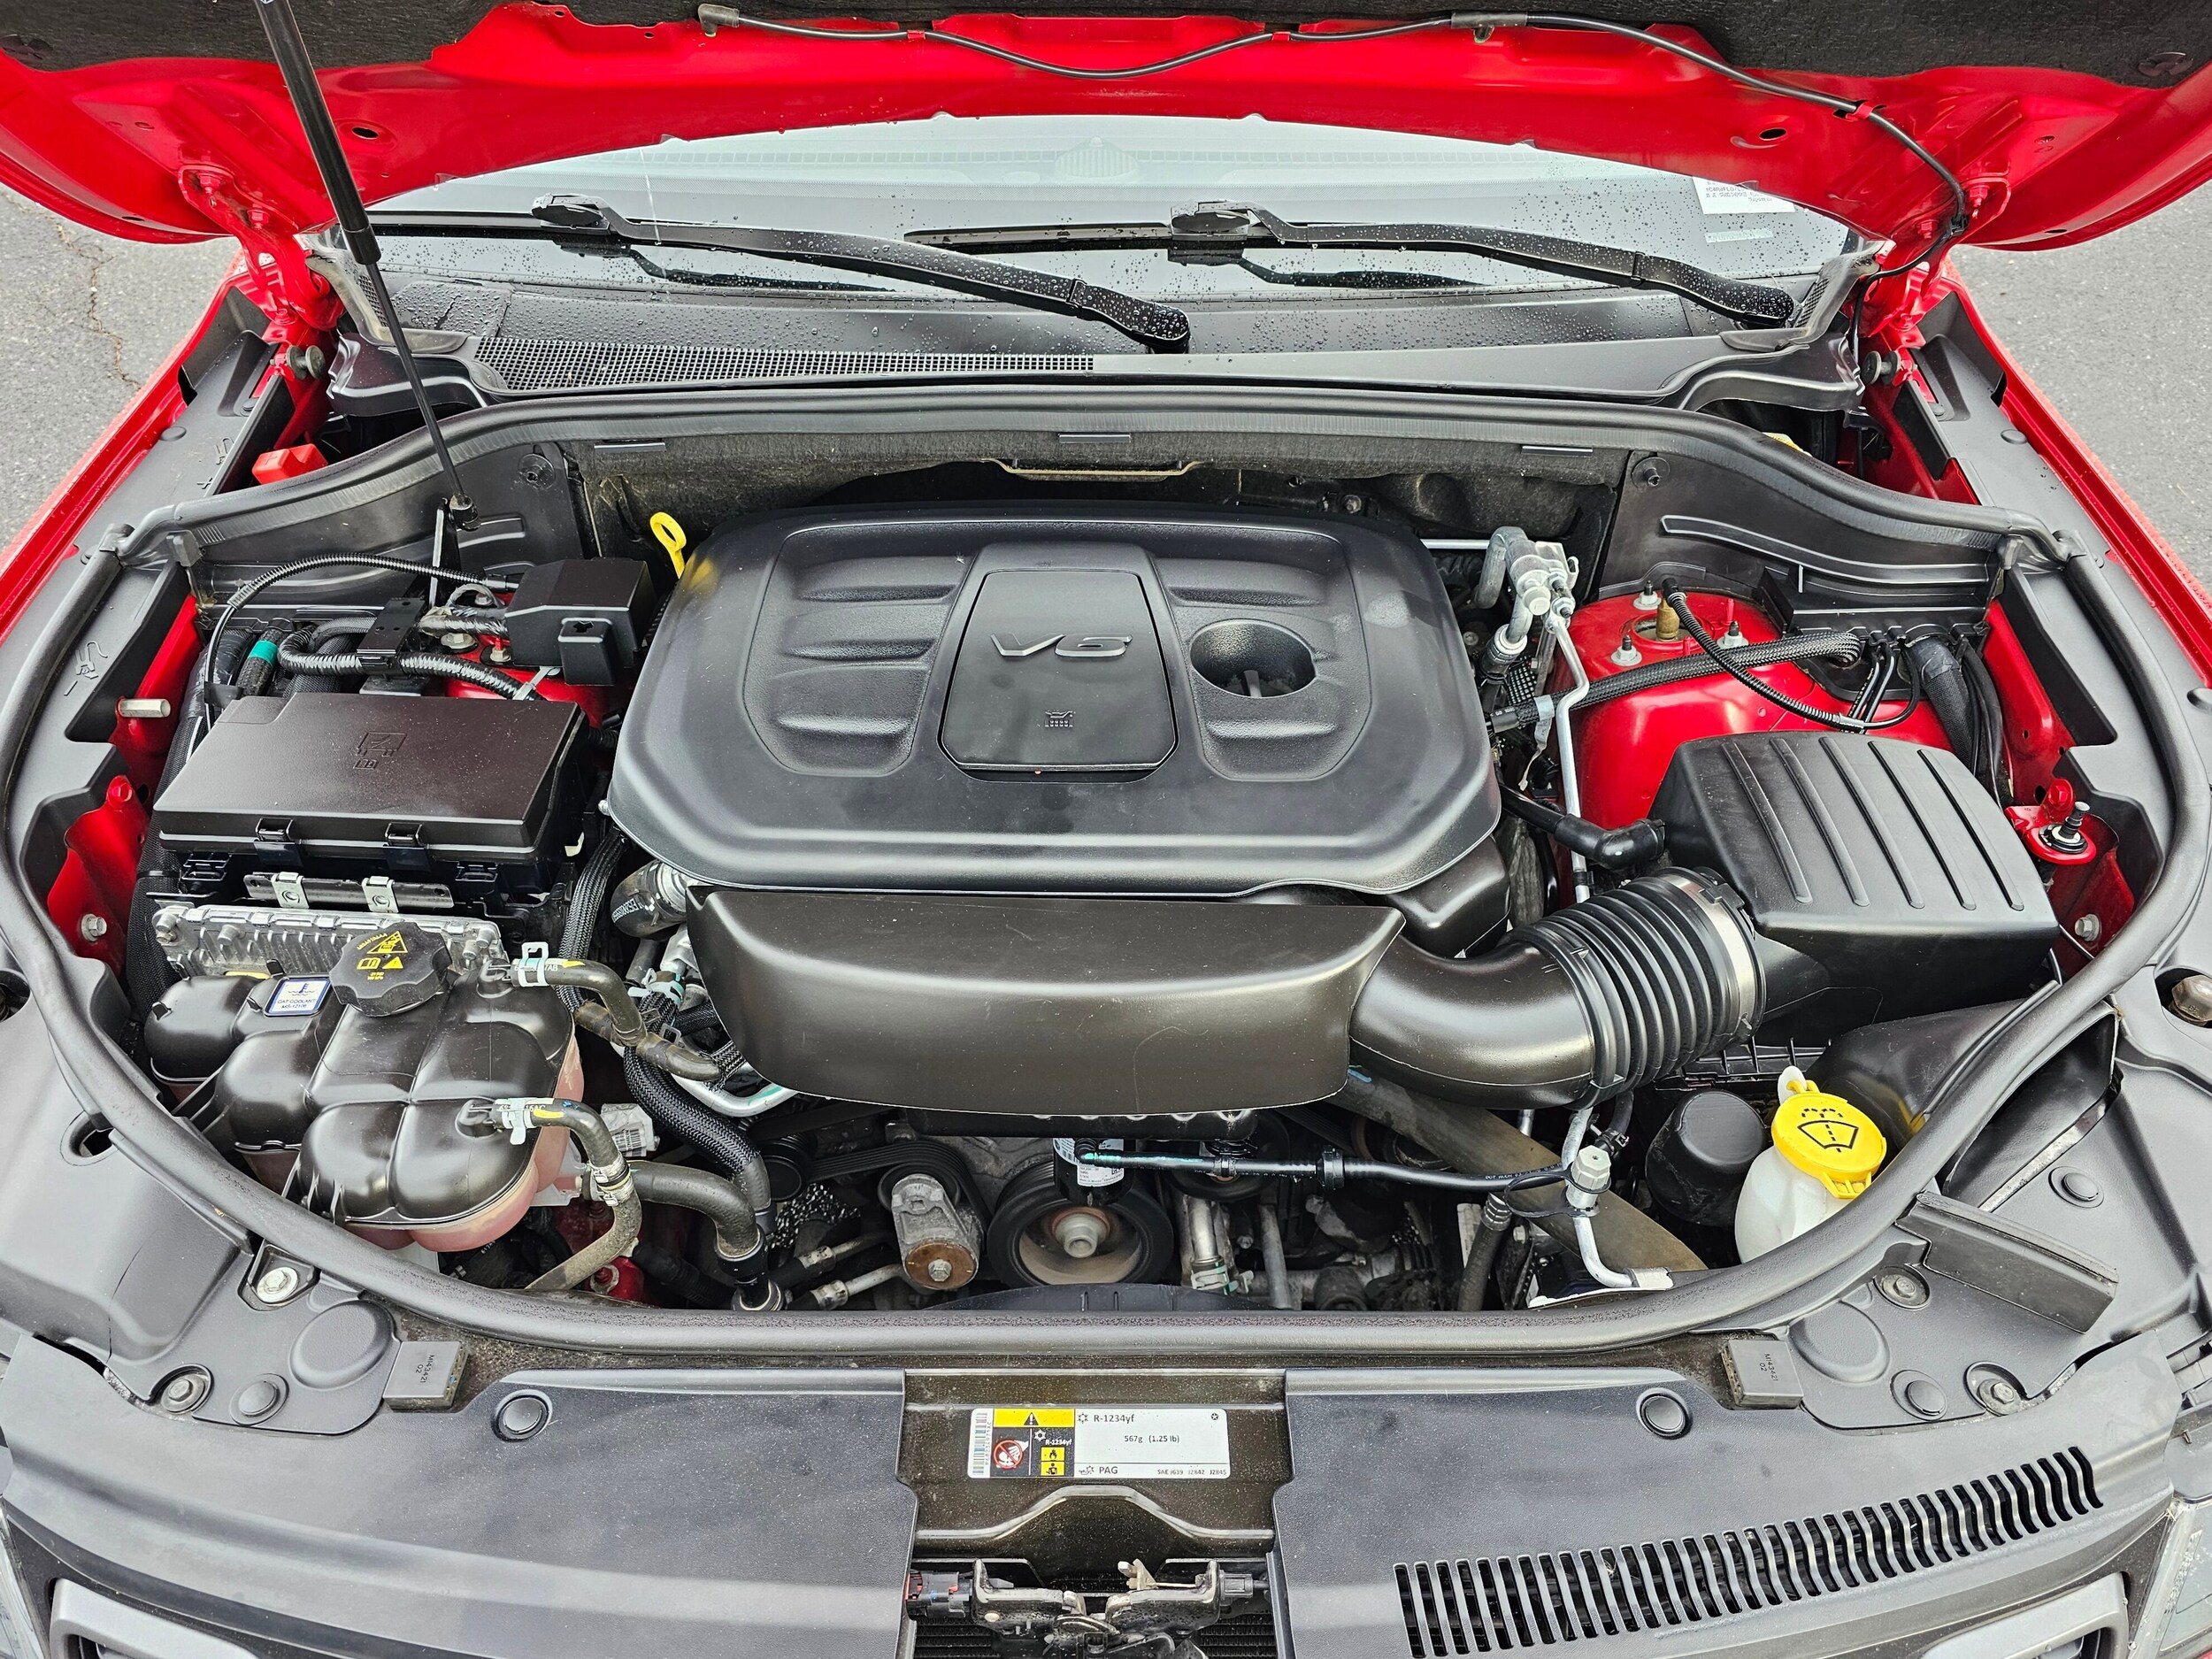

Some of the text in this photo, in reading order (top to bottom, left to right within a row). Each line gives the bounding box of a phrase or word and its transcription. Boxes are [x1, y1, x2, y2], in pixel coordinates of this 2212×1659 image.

[990, 633, 1133, 657] V6
[415, 1363, 424, 1373] 02
[420, 1355, 434, 1382] M143421
[1759, 1363, 1767, 1371] 02
[1764, 1354, 1778, 1381] M143421
[1094, 1414, 1135, 1425] R-1234yf
[1148, 1434, 1168, 1443] (1.25
[1170, 1434, 1180, 1443] lb)
[1098, 1465, 1118, 1475] PAG
